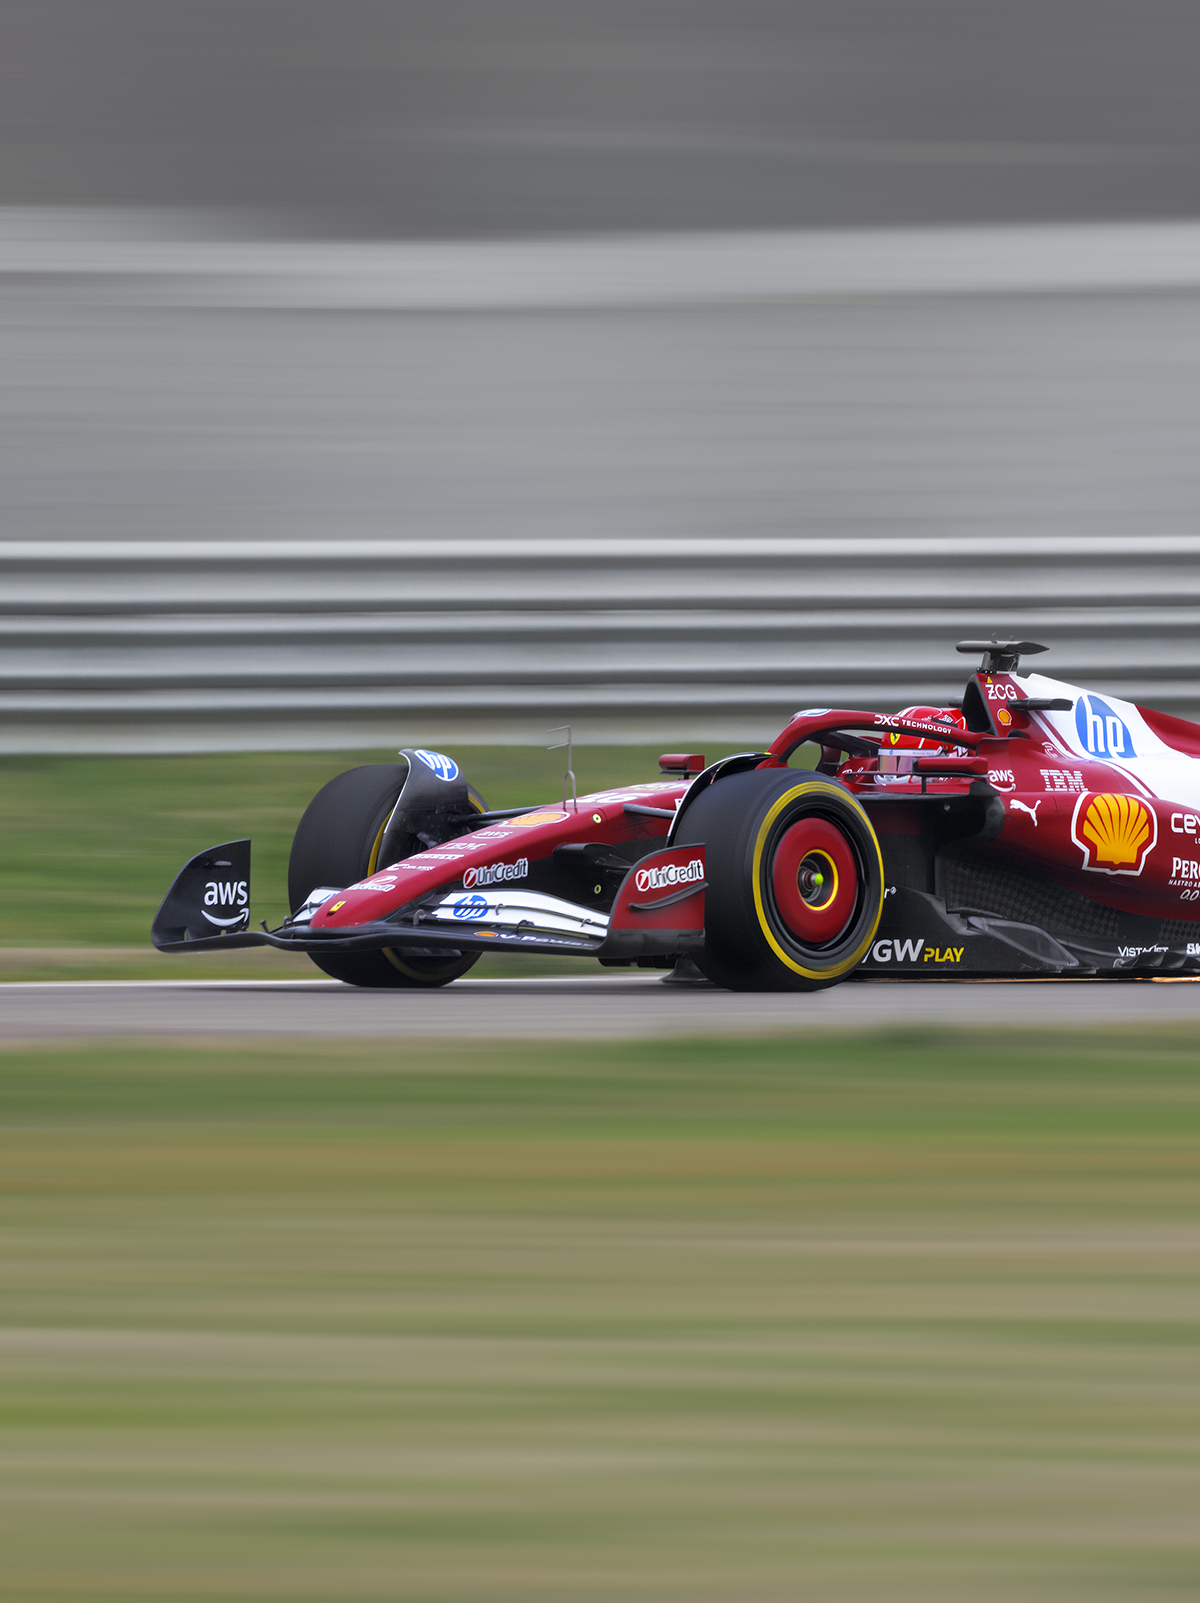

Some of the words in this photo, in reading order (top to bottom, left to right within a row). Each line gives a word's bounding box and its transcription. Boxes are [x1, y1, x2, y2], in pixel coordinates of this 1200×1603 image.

[874, 714, 900, 727] DXC
[902, 719, 952, 734] TECHNOLOGY
[414, 750, 457, 781] hp
[987, 770, 1015, 782] aws
[1040, 769, 1088, 791] IBM
[477, 858, 528, 885] UniCredit
[650, 860, 703, 888] UniCredit
[204, 881, 248, 905] aws
[454, 895, 488, 920] hp
[924, 947, 964, 962] PLAY
